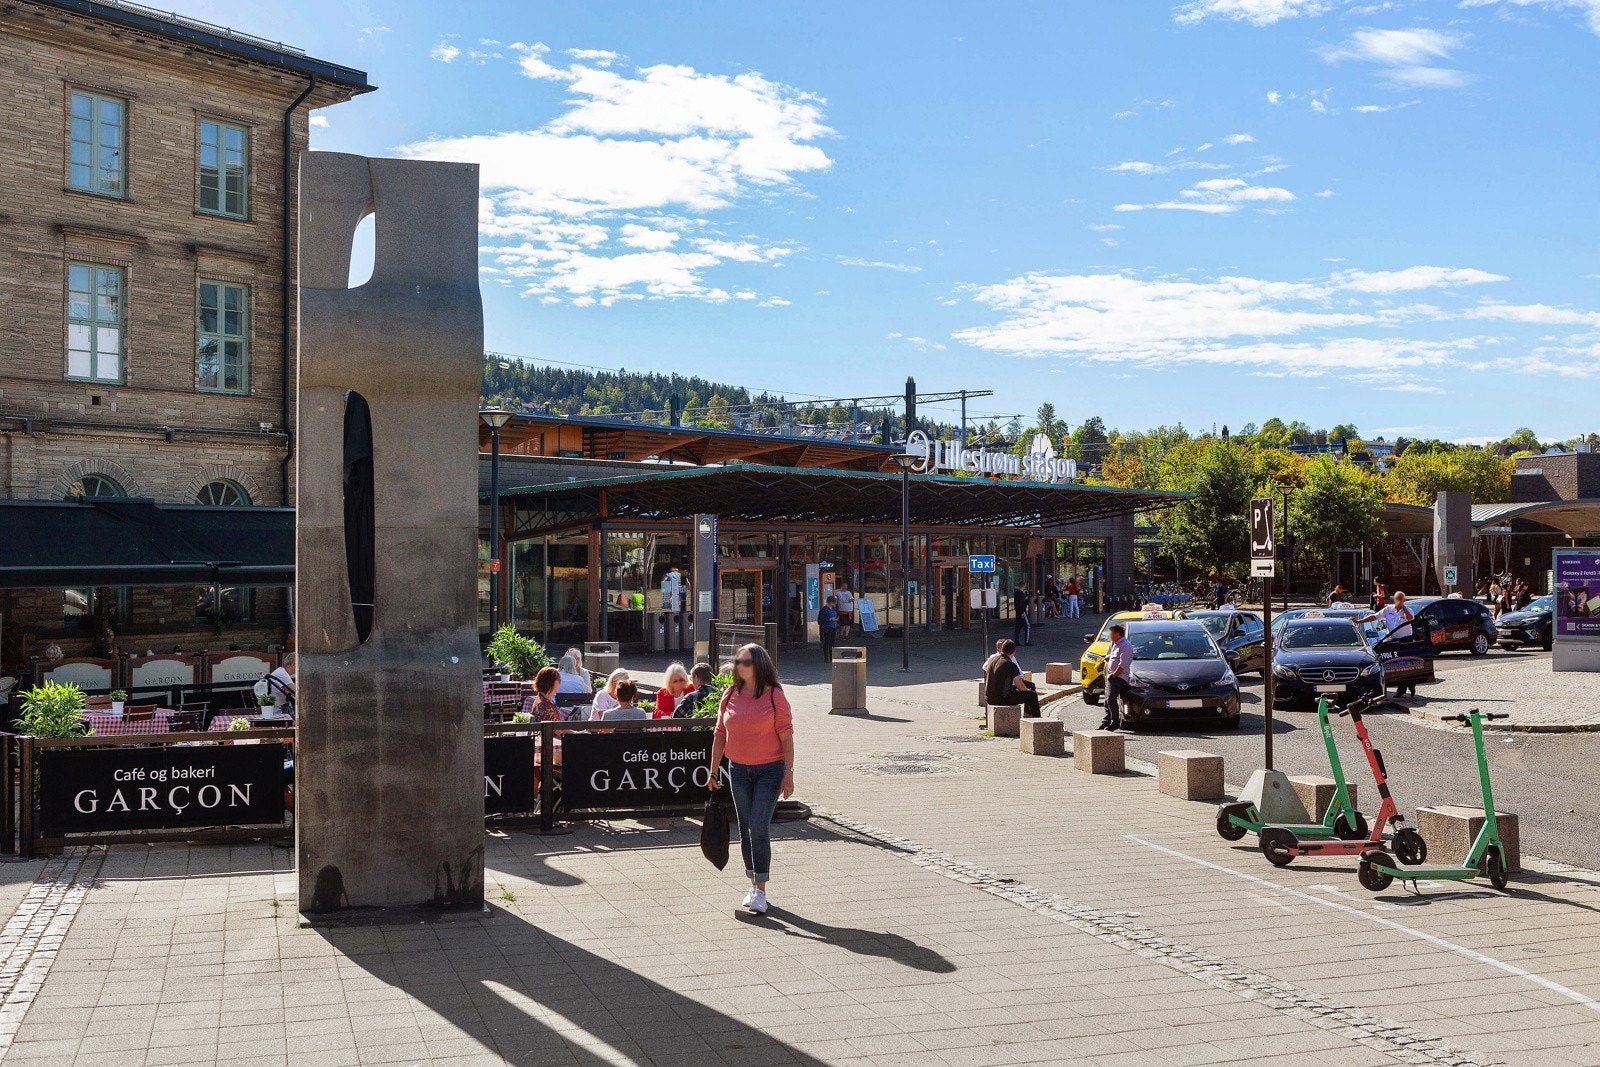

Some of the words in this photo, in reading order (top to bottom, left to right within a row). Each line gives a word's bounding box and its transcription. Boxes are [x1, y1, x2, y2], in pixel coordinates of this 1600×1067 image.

[935, 439, 1021, 475] Lillestrøm
[1022, 449, 1077, 483] stasjon
[1254, 508, 1261, 529] P
[971, 559, 994, 569] Taxi
[622, 750, 649, 762] Café
[652, 751, 667, 763] og
[670, 749, 706, 761] bakeri
[114, 767, 146, 782] Café
[150, 769, 168, 782] og
[171, 766, 215, 779] bakeri
[74, 783, 253, 815] GARÇON
